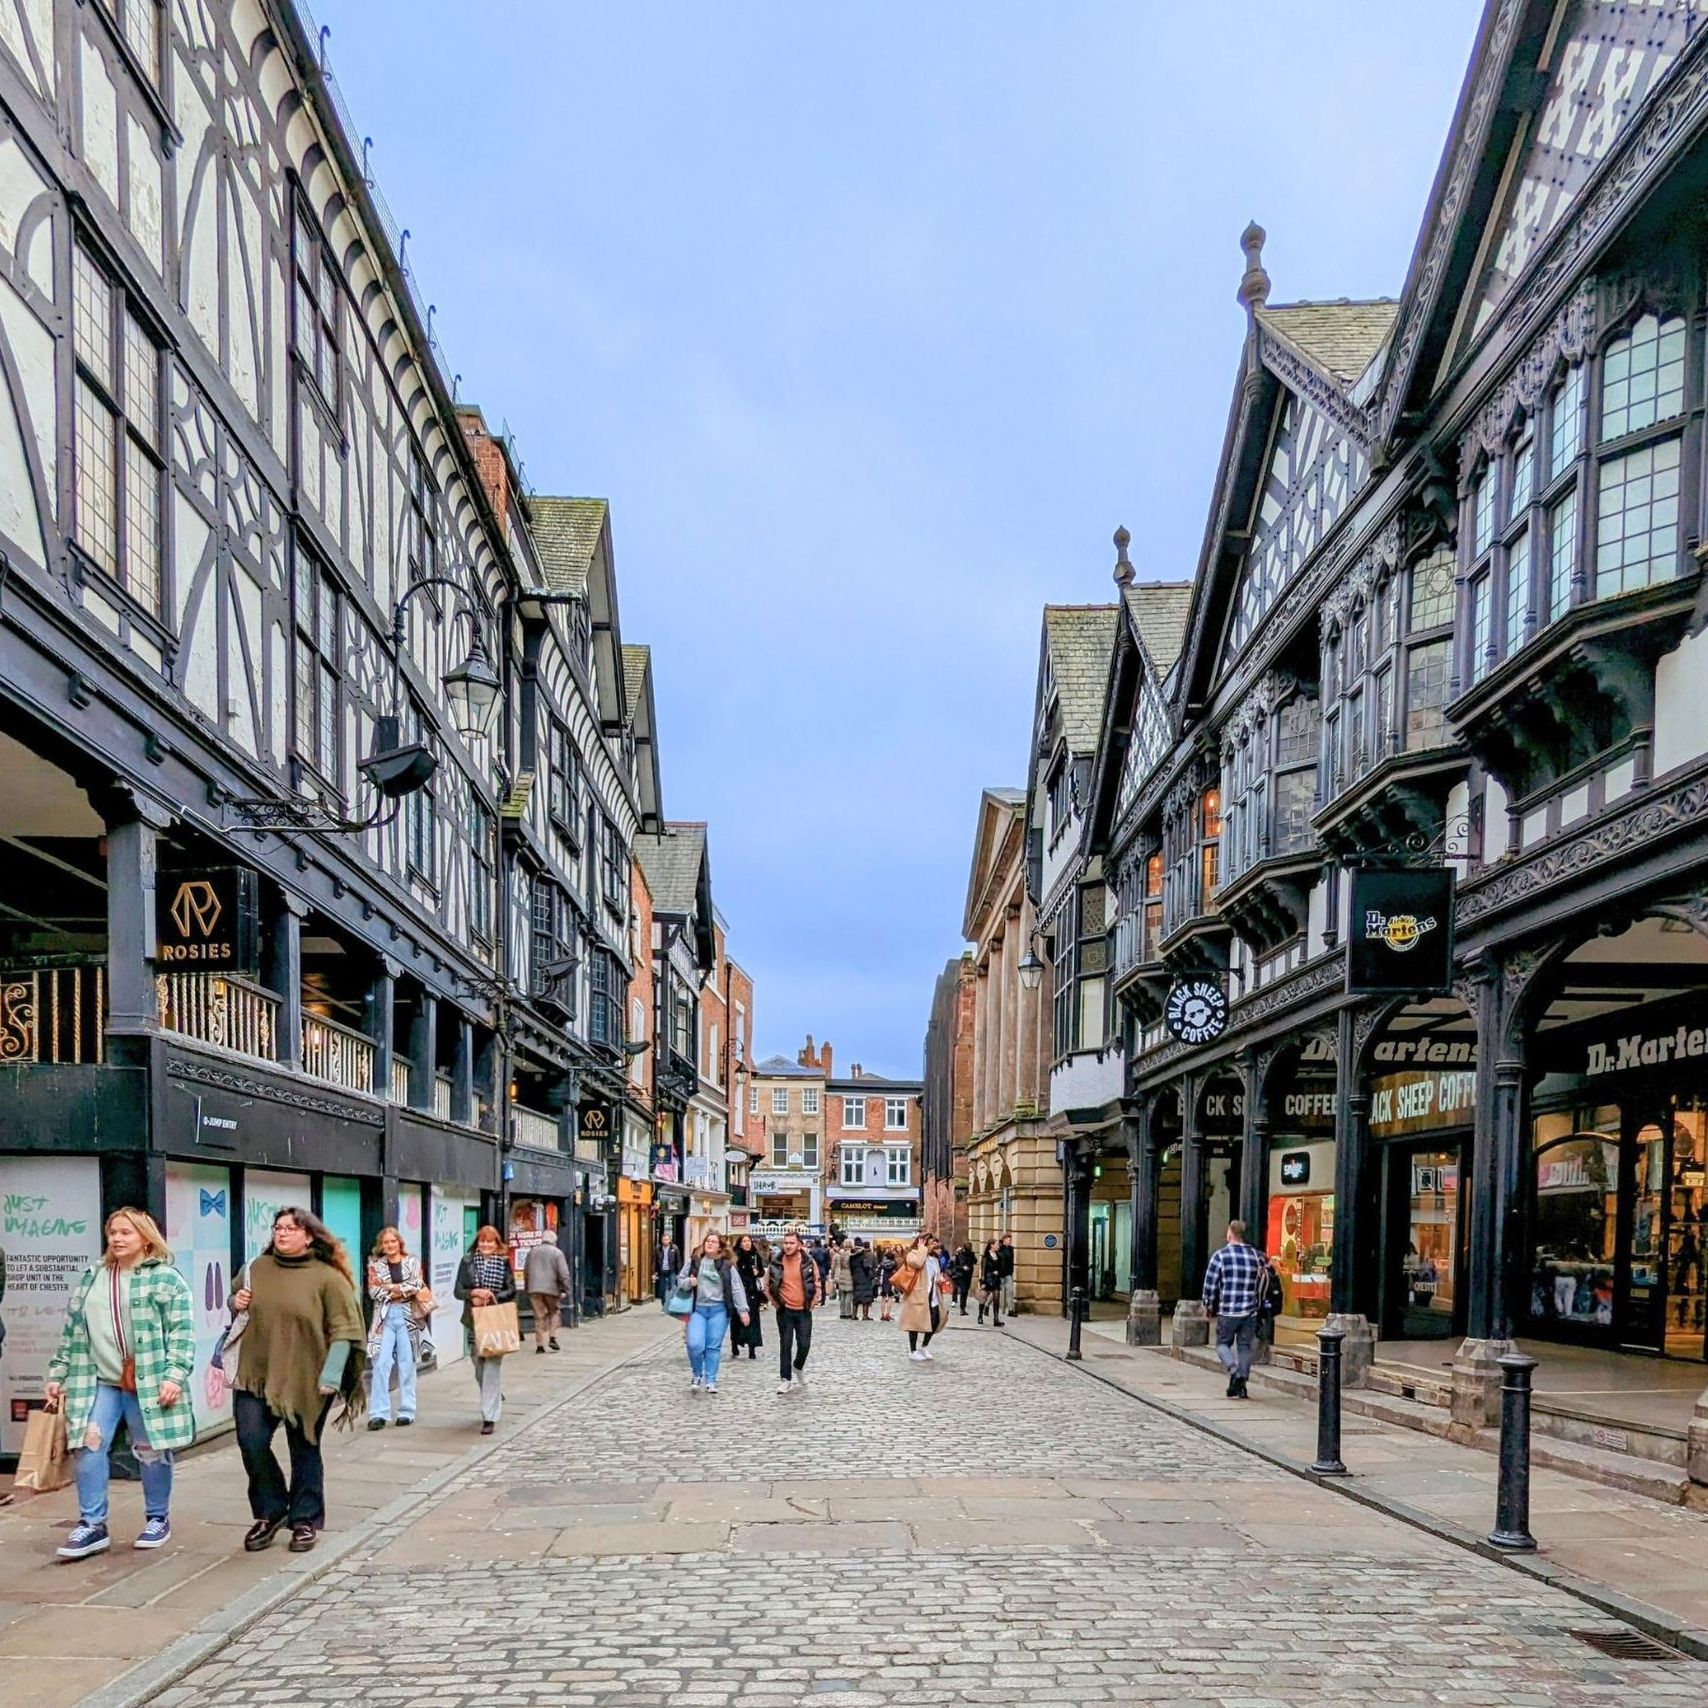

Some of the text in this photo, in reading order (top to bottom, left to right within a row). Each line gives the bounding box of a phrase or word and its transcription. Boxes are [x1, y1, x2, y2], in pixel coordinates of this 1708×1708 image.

[1366, 916, 1437, 939] Martens
[162, 943, 231, 961] ROSIES
[1168, 982, 1225, 1019] BLACK SHEEP
[1181, 1018, 1224, 1042] COFFEE
[1373, 1036, 1478, 1063] arten
[1586, 1025, 1708, 1075] Dr.Marte
[1368, 1072, 1477, 1126] ACK SHEEP COFF
[4, 1194, 50, 1215] JUST
[841, 1202, 873, 1210] CAMELOT
[6, 1254, 88, 1263] FANTASTIC OPPORTUNITY
[7, 1264, 79, 1273] TO LET A SUBSTANTIAL
[7, 1283, 29, 1291] HEART
[30, 1283, 38, 1291] OF
